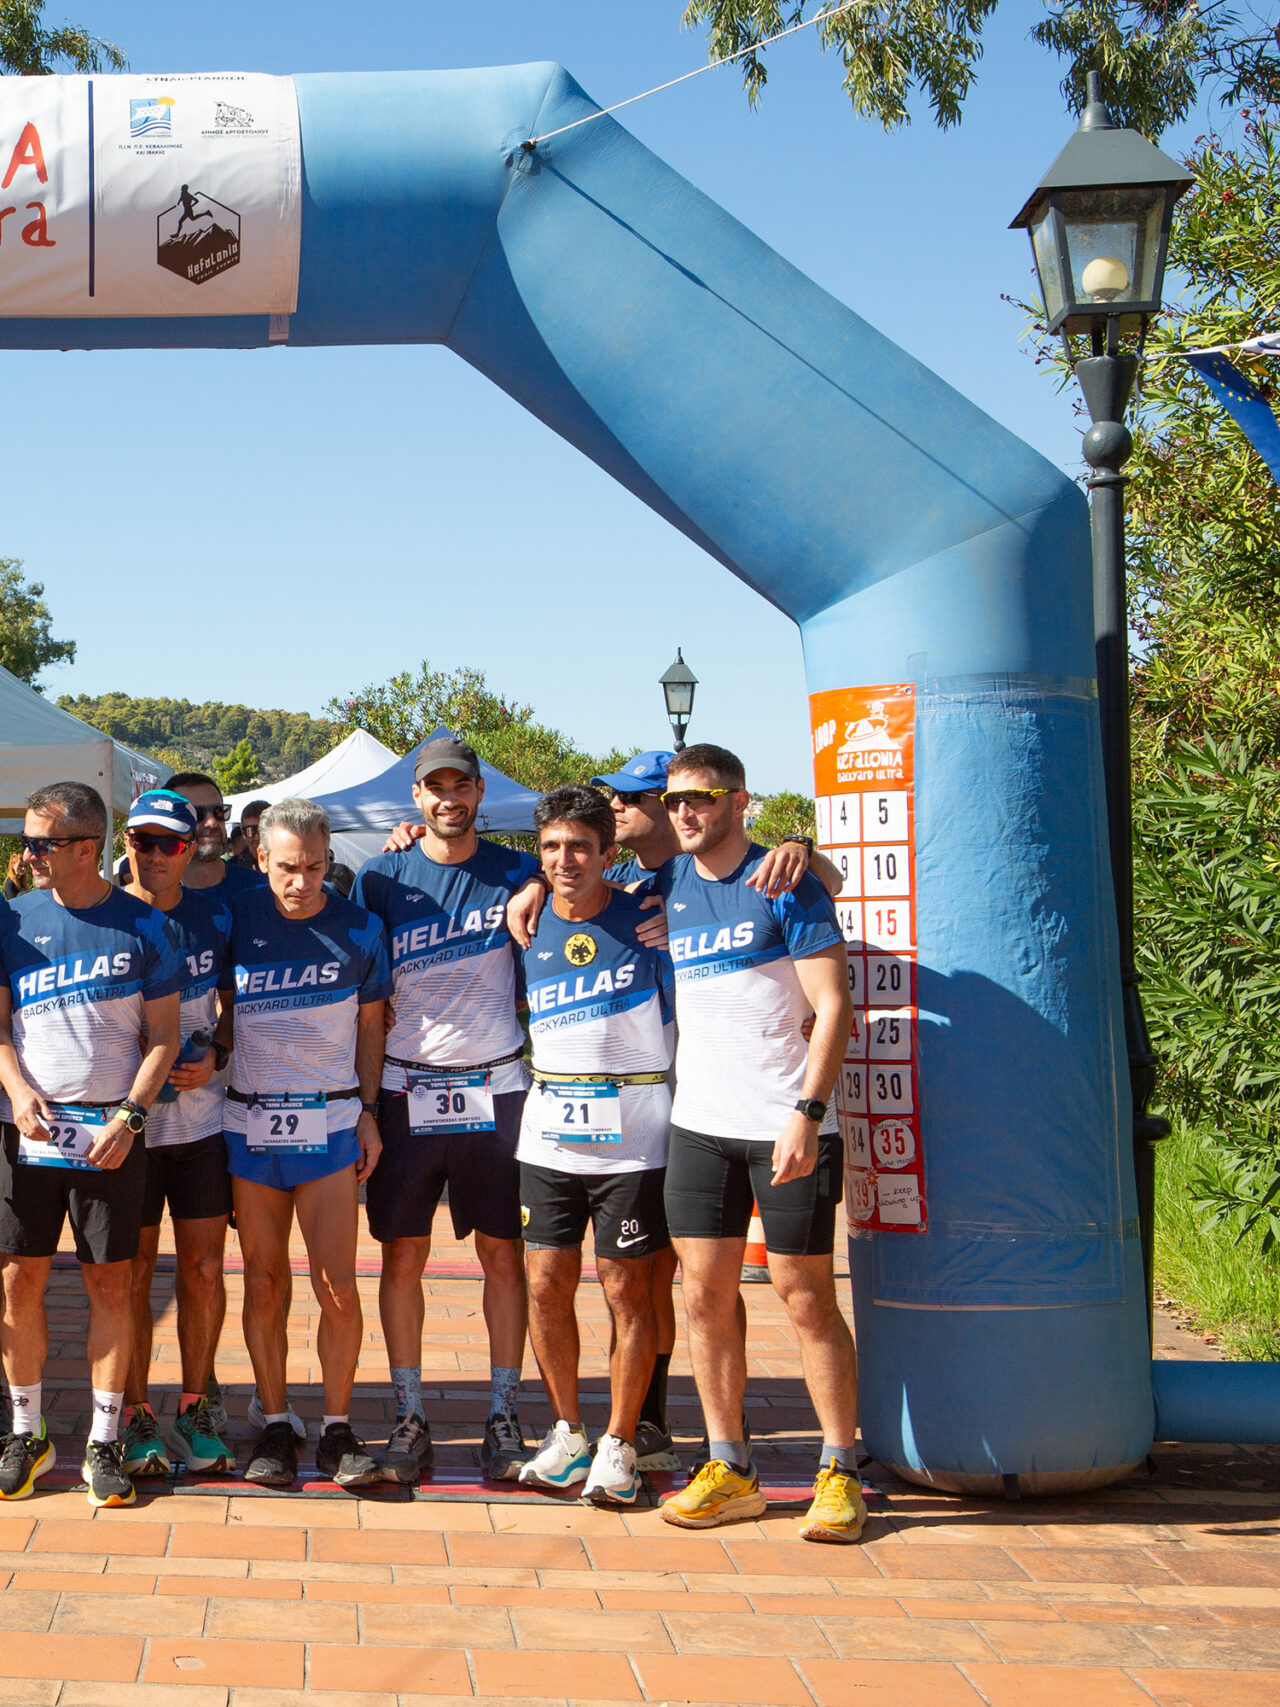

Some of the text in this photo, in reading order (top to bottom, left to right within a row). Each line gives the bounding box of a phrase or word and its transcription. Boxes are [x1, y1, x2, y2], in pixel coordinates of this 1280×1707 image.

[840, 801, 847, 826] 4
[878, 798, 888, 825] 5
[841, 855, 849, 881] 9
[874, 853, 897, 880] 10
[392, 904, 504, 960] HELLAS
[874, 909, 897, 936] 15
[19, 952, 131, 1000] HELLAS
[235, 961, 340, 996] HELLAS
[714, 957, 754, 974] ULTRA
[847, 963, 856, 991] 9
[876, 963, 901, 991] 20
[24, 985, 126, 1019] BACKYARD ULTRA
[293, 993, 333, 1007] ULTRA
[526, 964, 635, 1014] HELLAS
[591, 998, 630, 1017] ULTRA
[849, 1017, 860, 1043] 4
[876, 1018, 900, 1045] 25
[846, 1071, 861, 1099] 29
[876, 1073, 902, 1100] 30
[436, 1093, 466, 1115] 30
[563, 1103, 589, 1124] 21
[47, 1126, 77, 1148] 22
[270, 1114, 299, 1135] 29
[851, 1126, 865, 1153] 34
[880, 1128, 906, 1155] 35
[621, 1219, 639, 1235] 20
